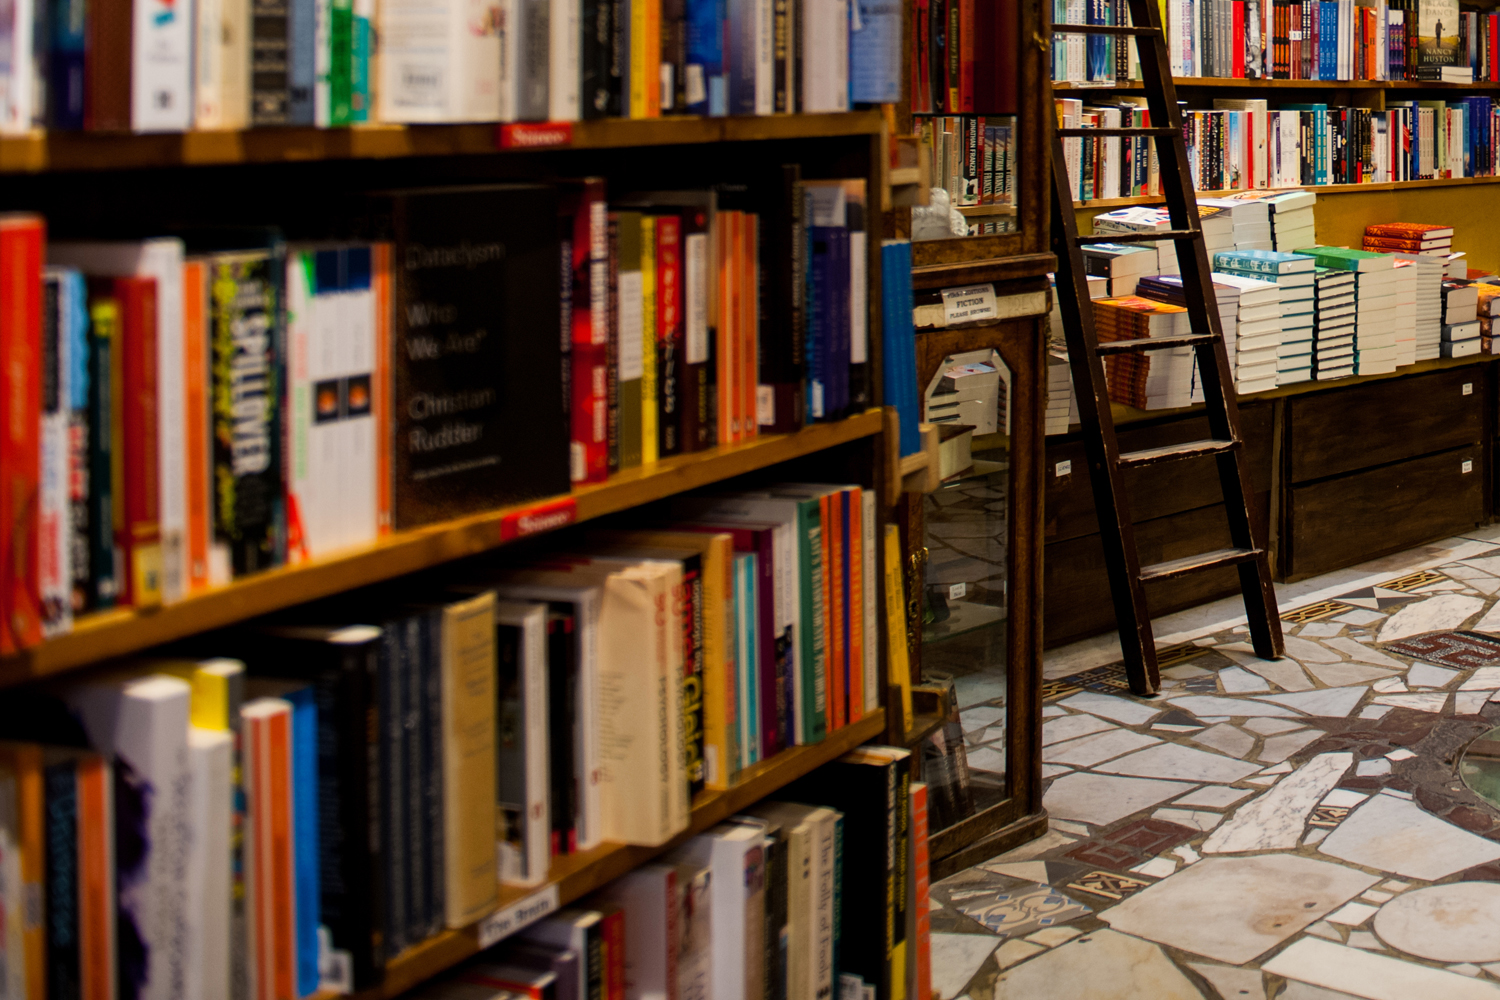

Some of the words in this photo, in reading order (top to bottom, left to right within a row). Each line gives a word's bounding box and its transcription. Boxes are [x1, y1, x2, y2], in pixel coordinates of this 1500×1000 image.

[1425, 8, 1454, 17] DANCE
[1426, 0, 1453, 9] BLACK
[1423, 55, 1455, 64] HUSTON
[1425, 47, 1453, 56] NANCY
[969, 118, 977, 149] JONATHAN
[969, 149, 977, 177] FRANZEN
[406, 301, 459, 328] Who
[949, 311, 968, 319] PLEASE
[956, 297, 984, 309] FICTION
[406, 333, 441, 361] We
[230, 312, 270, 476] SPILLOVER
[407, 388, 498, 421] Christian
[408, 423, 484, 453] Rudder
[851, 538, 861, 648] MASTERMIND
[657, 674, 670, 784] PSYCHOLOGY
[683, 676, 703, 784] Gleick
[887, 765, 897, 811] COLIN
[817, 834, 833, 866] The
[887, 813, 897, 872] WILSON
[815, 868, 832, 912] Folly
[817, 914, 832, 933] of
[816, 937, 832, 984] Fools
